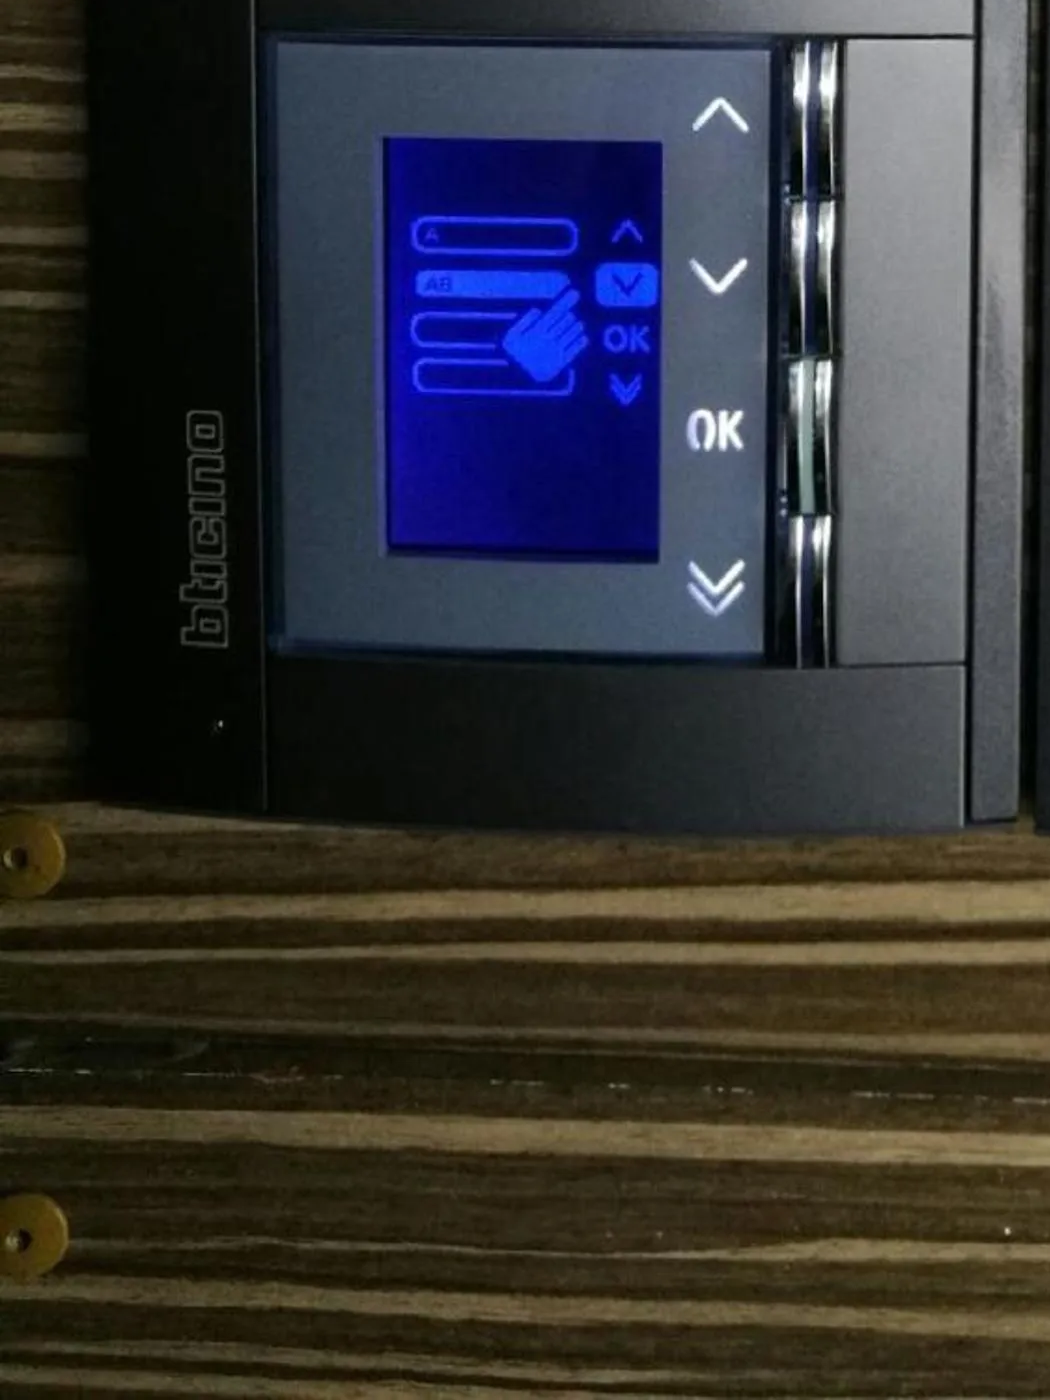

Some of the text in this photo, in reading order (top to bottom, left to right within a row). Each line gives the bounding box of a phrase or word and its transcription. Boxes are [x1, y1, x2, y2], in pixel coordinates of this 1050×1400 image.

[603, 323, 651, 355] OK
[686, 409, 745, 452] OK
[179, 409, 229, 649] bticino
